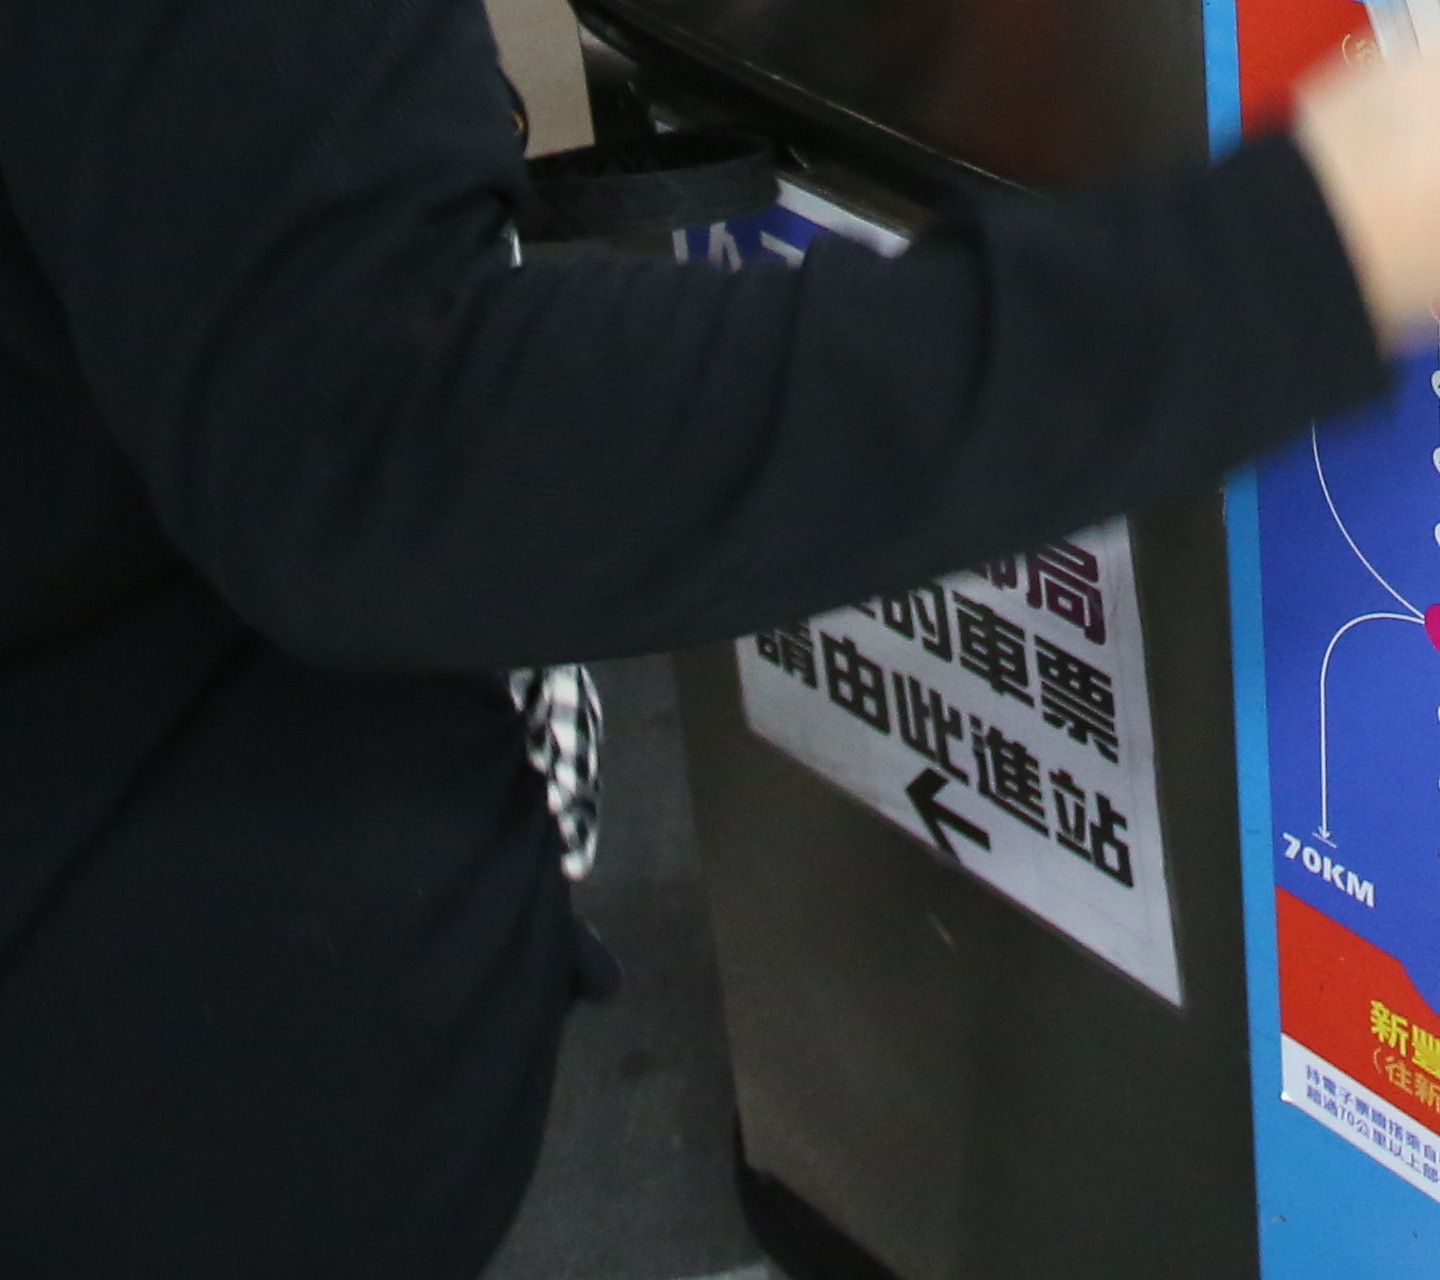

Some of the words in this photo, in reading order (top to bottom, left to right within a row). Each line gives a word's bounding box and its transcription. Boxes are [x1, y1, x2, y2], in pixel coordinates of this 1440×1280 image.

[856, 587, 1121, 766] 的車票
[1282, 832, 1376, 909] 70KM
